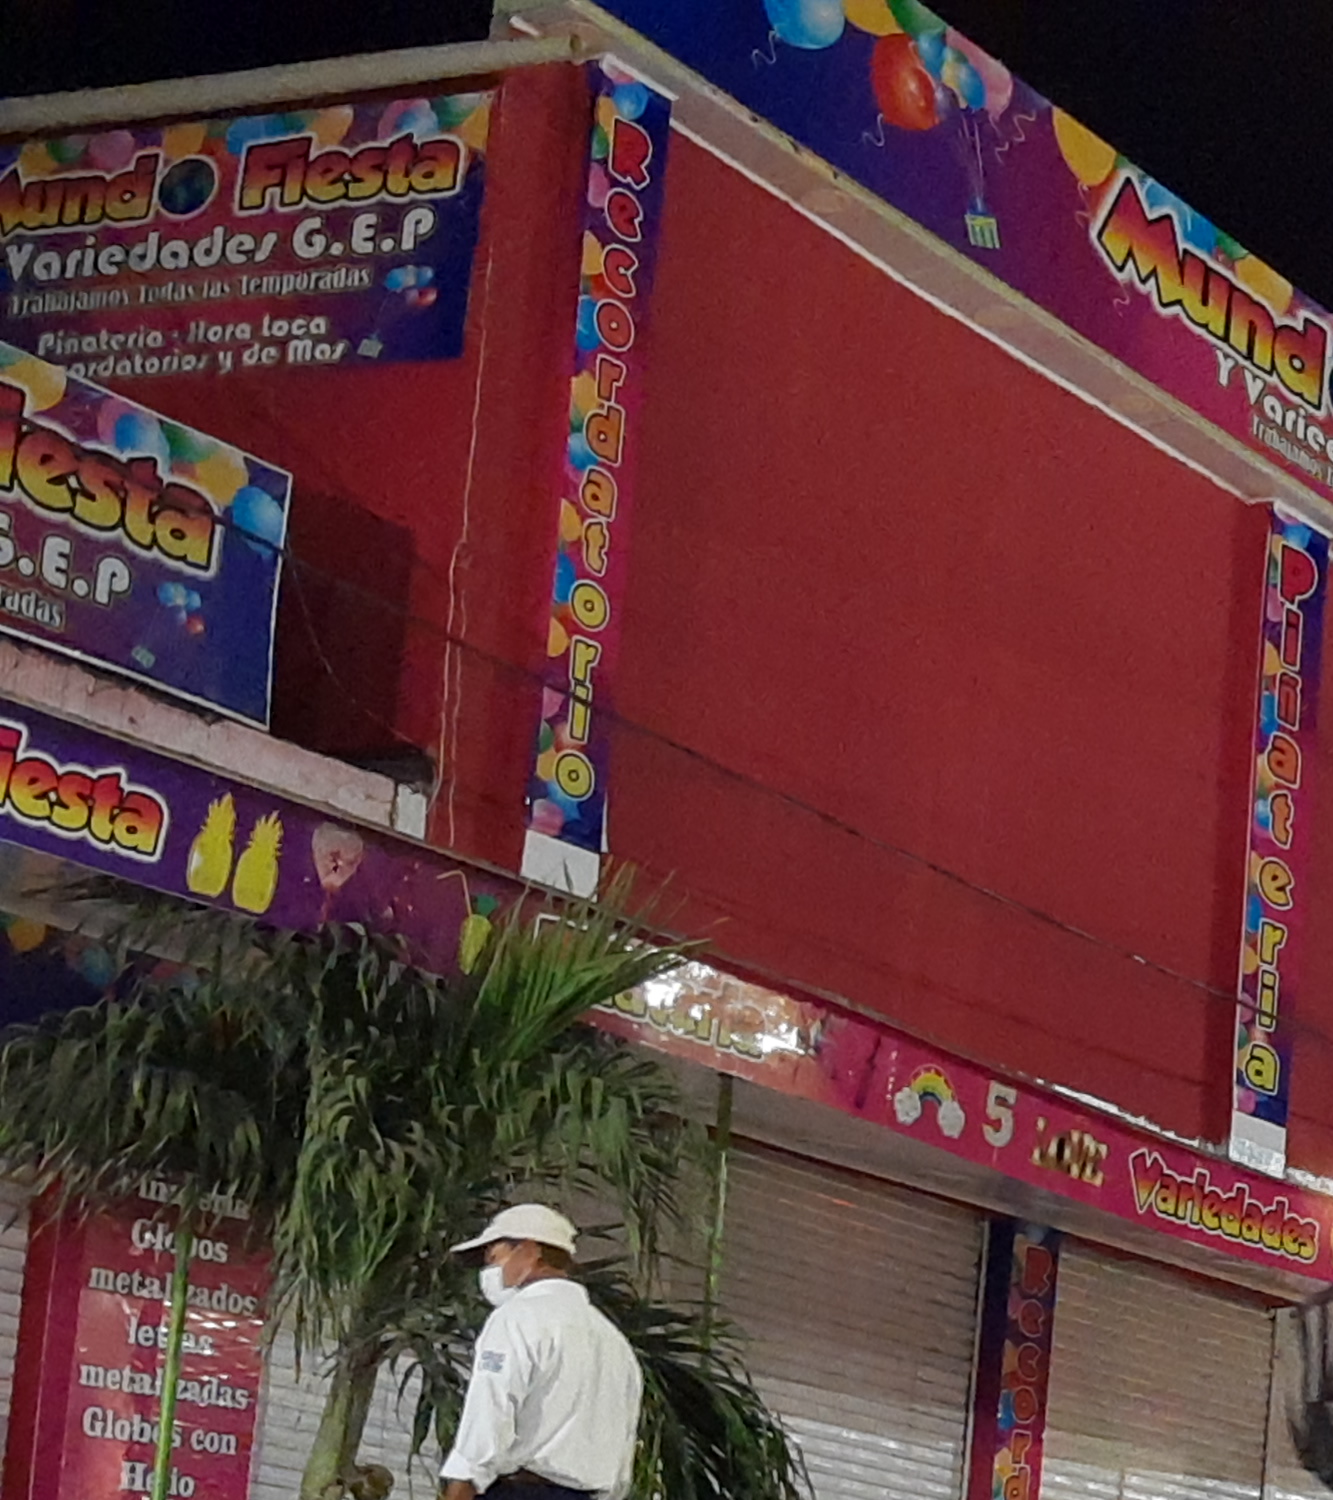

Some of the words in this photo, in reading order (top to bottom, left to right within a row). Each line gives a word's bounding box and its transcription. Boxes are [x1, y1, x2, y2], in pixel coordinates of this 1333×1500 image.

[236, 131, 465, 213] Fiesta
[7, 226, 278, 282] Variedades
[292, 205, 435, 260] G.E.P
[218, 350, 233, 374] y
[242, 341, 280, 366] de
[1129, 1148, 1319, 1264] Variedades
[131, 1218, 229, 1264] Gloos
[88, 1266, 258, 1317] metalzados
[128, 1316, 215, 1357] letas
[79, 1363, 249, 1411] metalzadas
[190, 1428, 237, 1455] con
[118, 1461, 195, 1498] Heio
